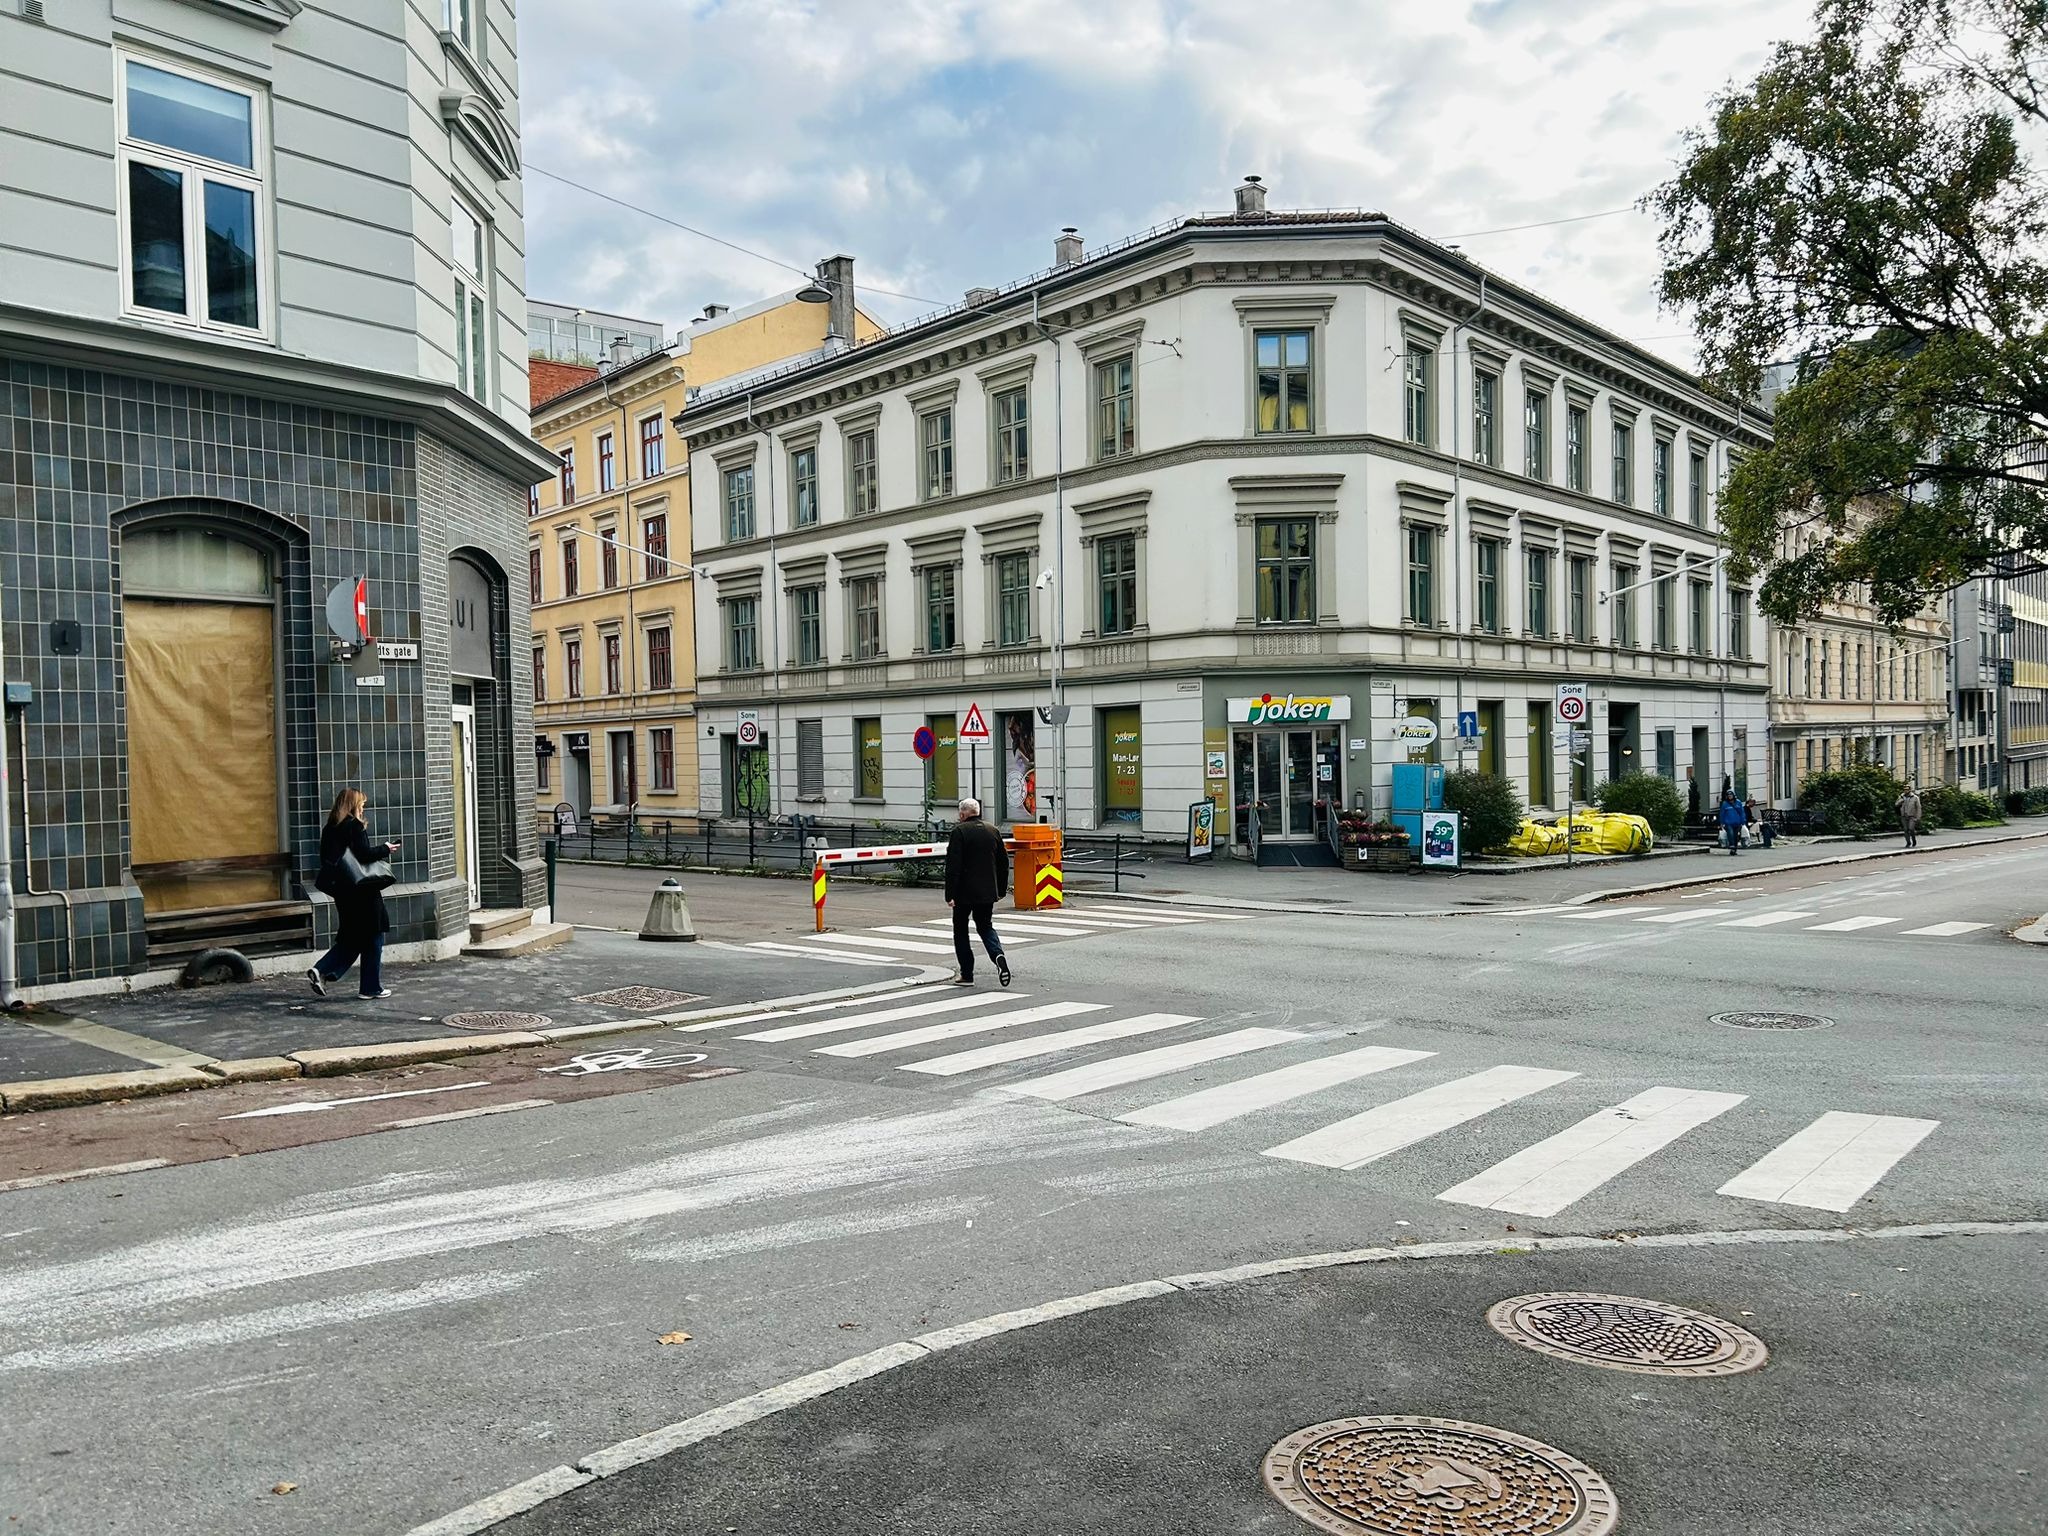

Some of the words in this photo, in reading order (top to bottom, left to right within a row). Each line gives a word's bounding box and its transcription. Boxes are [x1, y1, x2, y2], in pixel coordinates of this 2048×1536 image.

[394, 648, 412, 657] gate
[373, 677, 379, 685] 12
[1562, 686, 1582, 694] Sone
[1252, 692, 1328, 726] joker
[1564, 702, 1579, 714] 30
[740, 711, 756, 719] Sone
[743, 727, 754, 737] 30
[1403, 725, 1431, 738] joker
[1114, 732, 1135, 744] joker
[1117, 765, 1121, 775] 7
[1127, 765, 1136, 775] 23
[1435, 826, 1448, 836] 39
